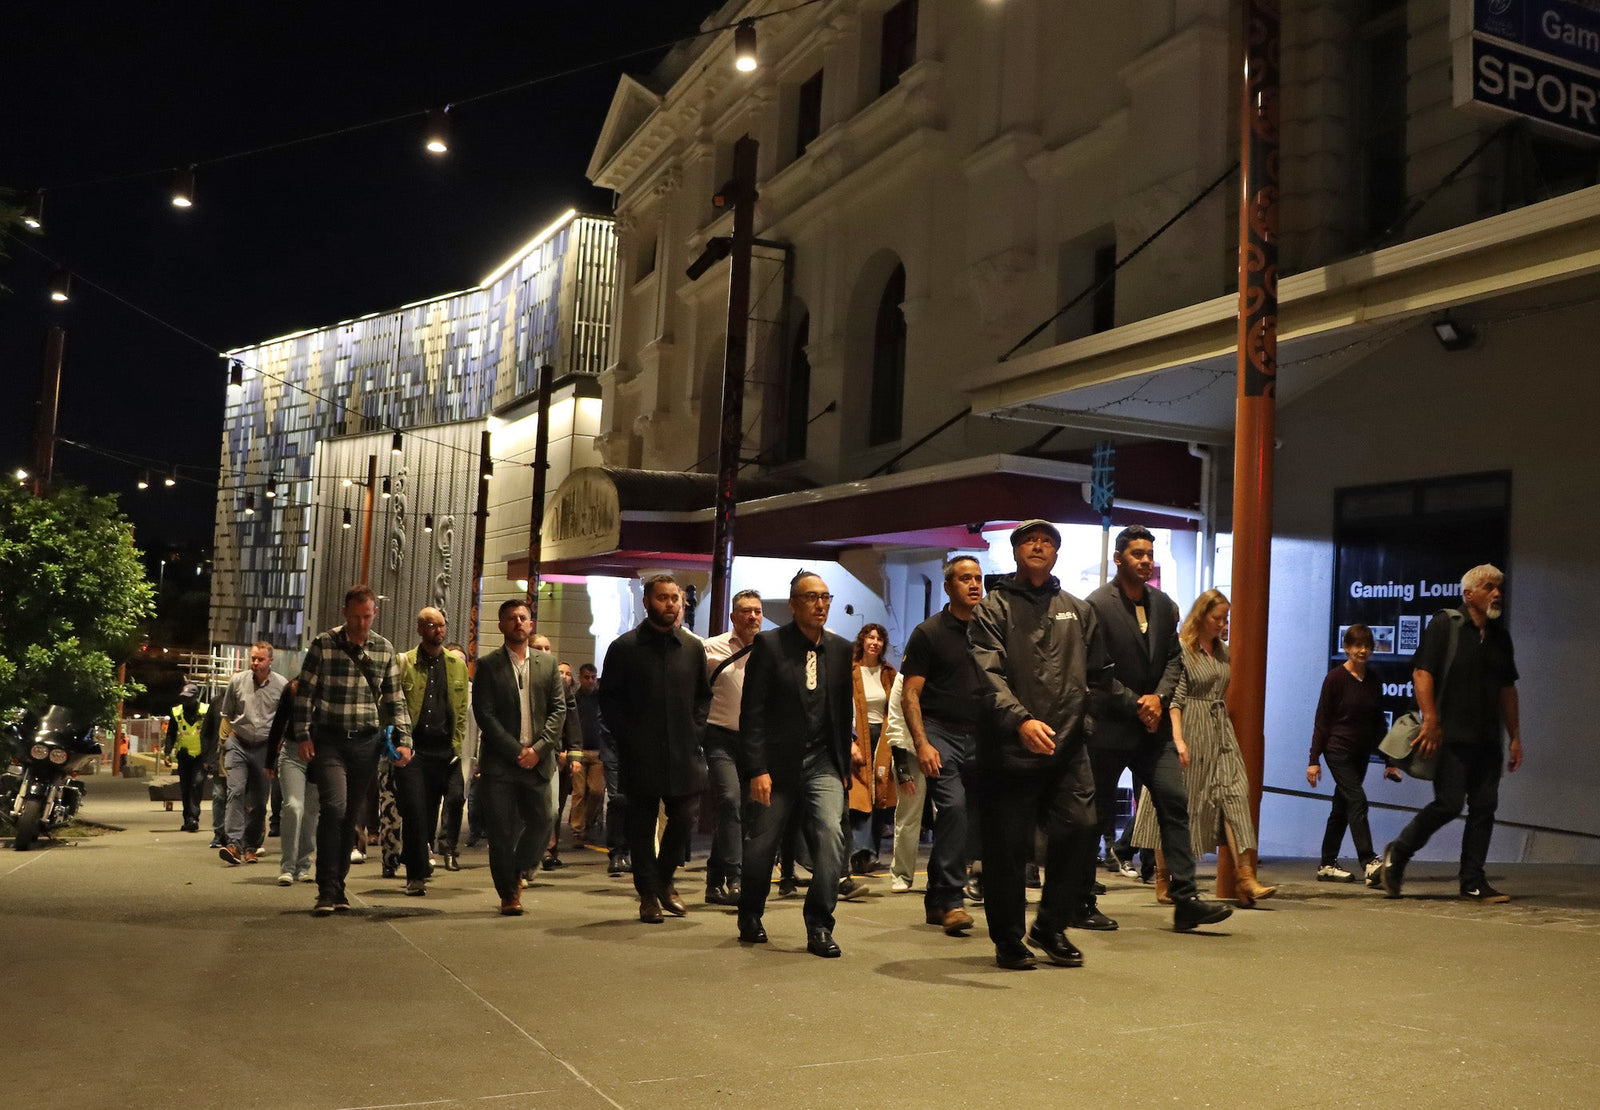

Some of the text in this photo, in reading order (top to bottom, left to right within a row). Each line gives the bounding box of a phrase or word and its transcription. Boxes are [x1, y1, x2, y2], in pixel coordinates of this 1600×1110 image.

[1542, 9, 1599, 53] Gam
[1478, 54, 1600, 125] SPOR
[1350, 580, 1462, 601] Gaming Loun
